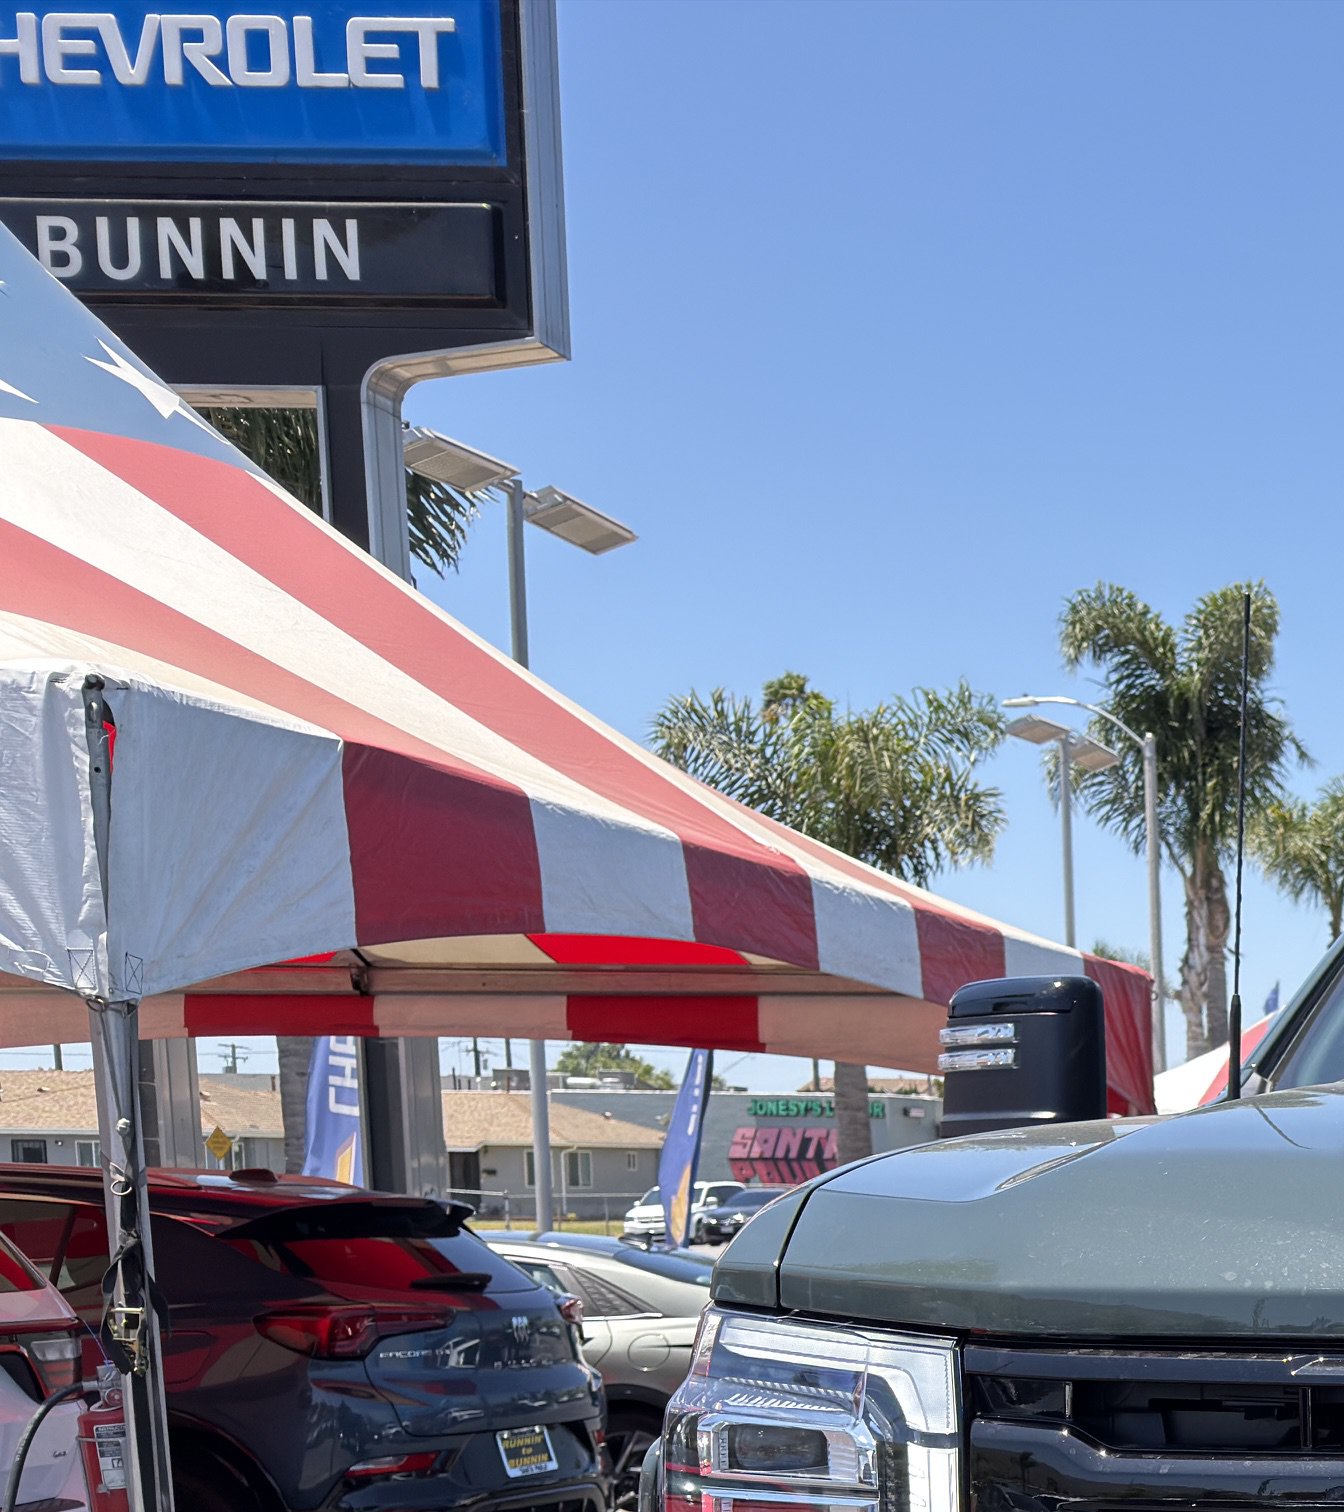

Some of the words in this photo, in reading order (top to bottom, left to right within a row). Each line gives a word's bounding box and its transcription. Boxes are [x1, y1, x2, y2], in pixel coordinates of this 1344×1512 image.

[0, 12, 456, 88] HEVROLET
[36, 214, 361, 282] BUNNIN
[747, 1099, 822, 1118] JONESY'S
